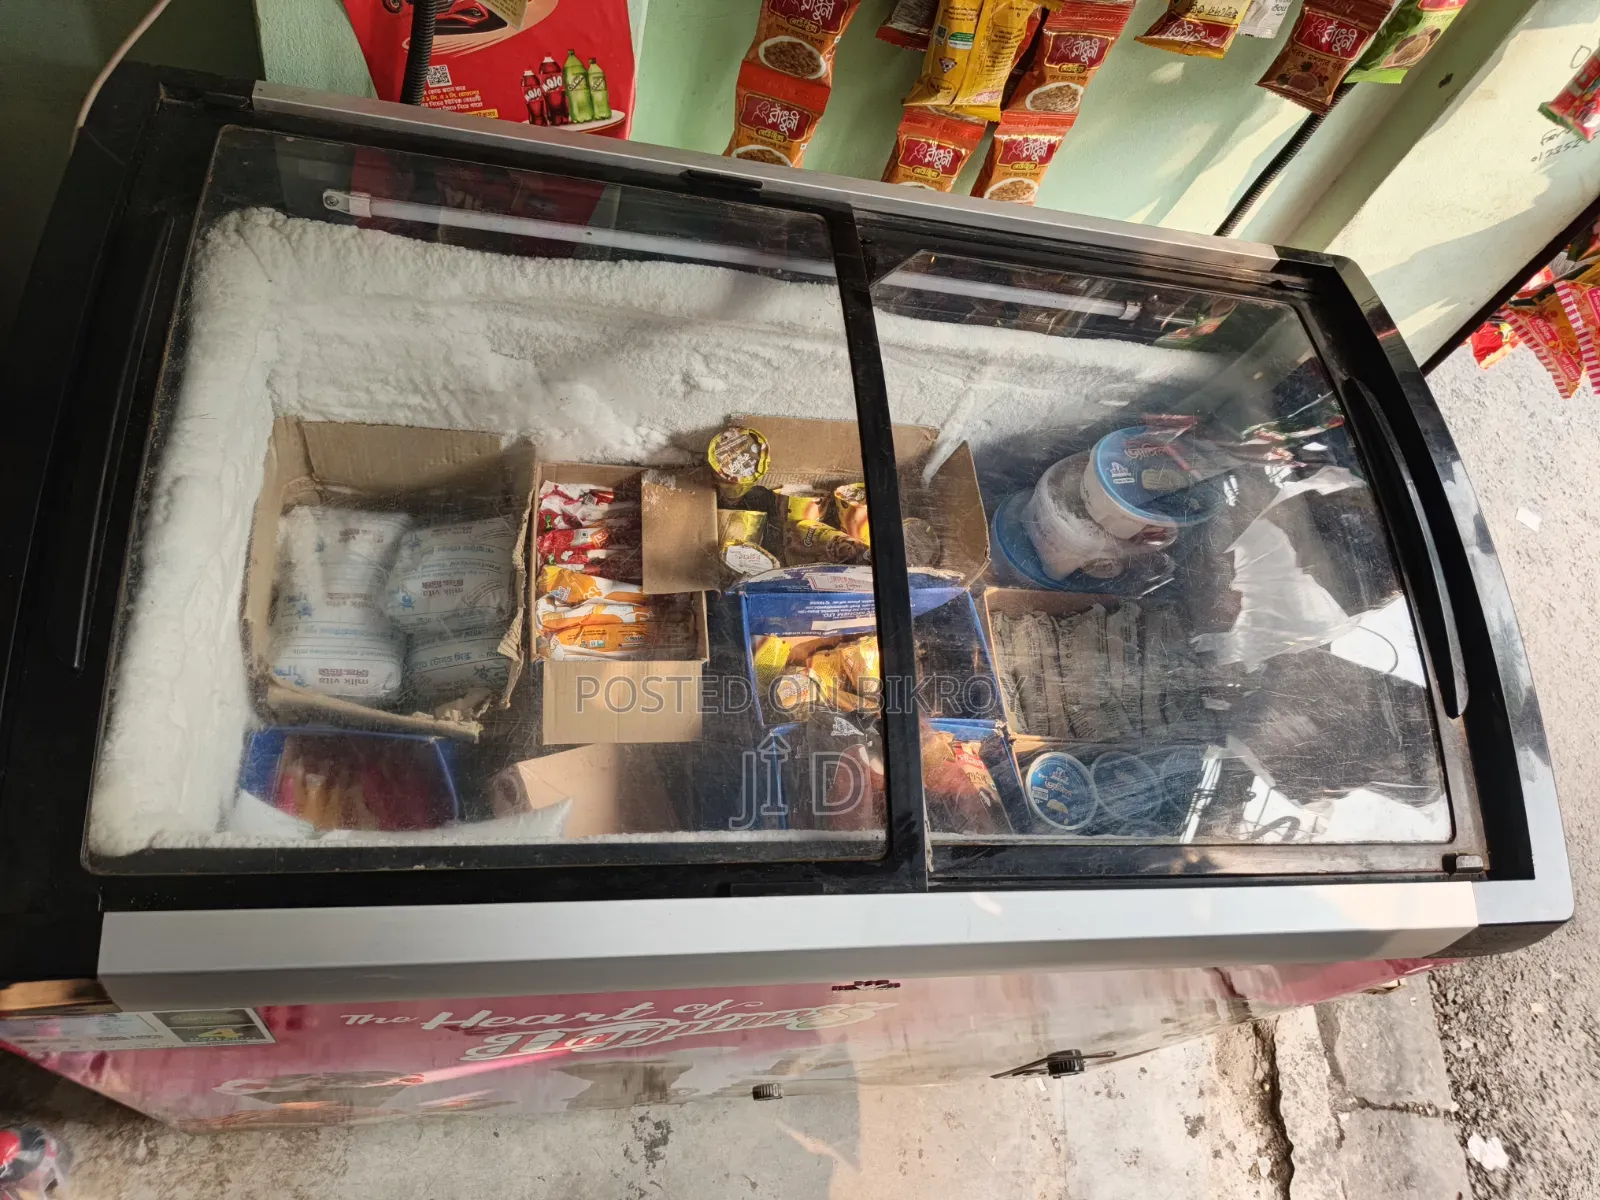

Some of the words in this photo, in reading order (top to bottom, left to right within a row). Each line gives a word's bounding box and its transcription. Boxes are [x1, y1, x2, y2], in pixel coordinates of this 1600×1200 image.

[542, 76, 563, 93] MOJO
[768, 103, 800, 135] রাঁধুনী
[924, 141, 954, 173] রাঁধুনী
[422, 590, 441, 598] vita
[318, 677, 340, 685] vita
[344, 678, 369, 686] milk
[340, 1013, 419, 1025] The
[420, 1001, 660, 1030] Heart
[672, 999, 764, 1019] of
